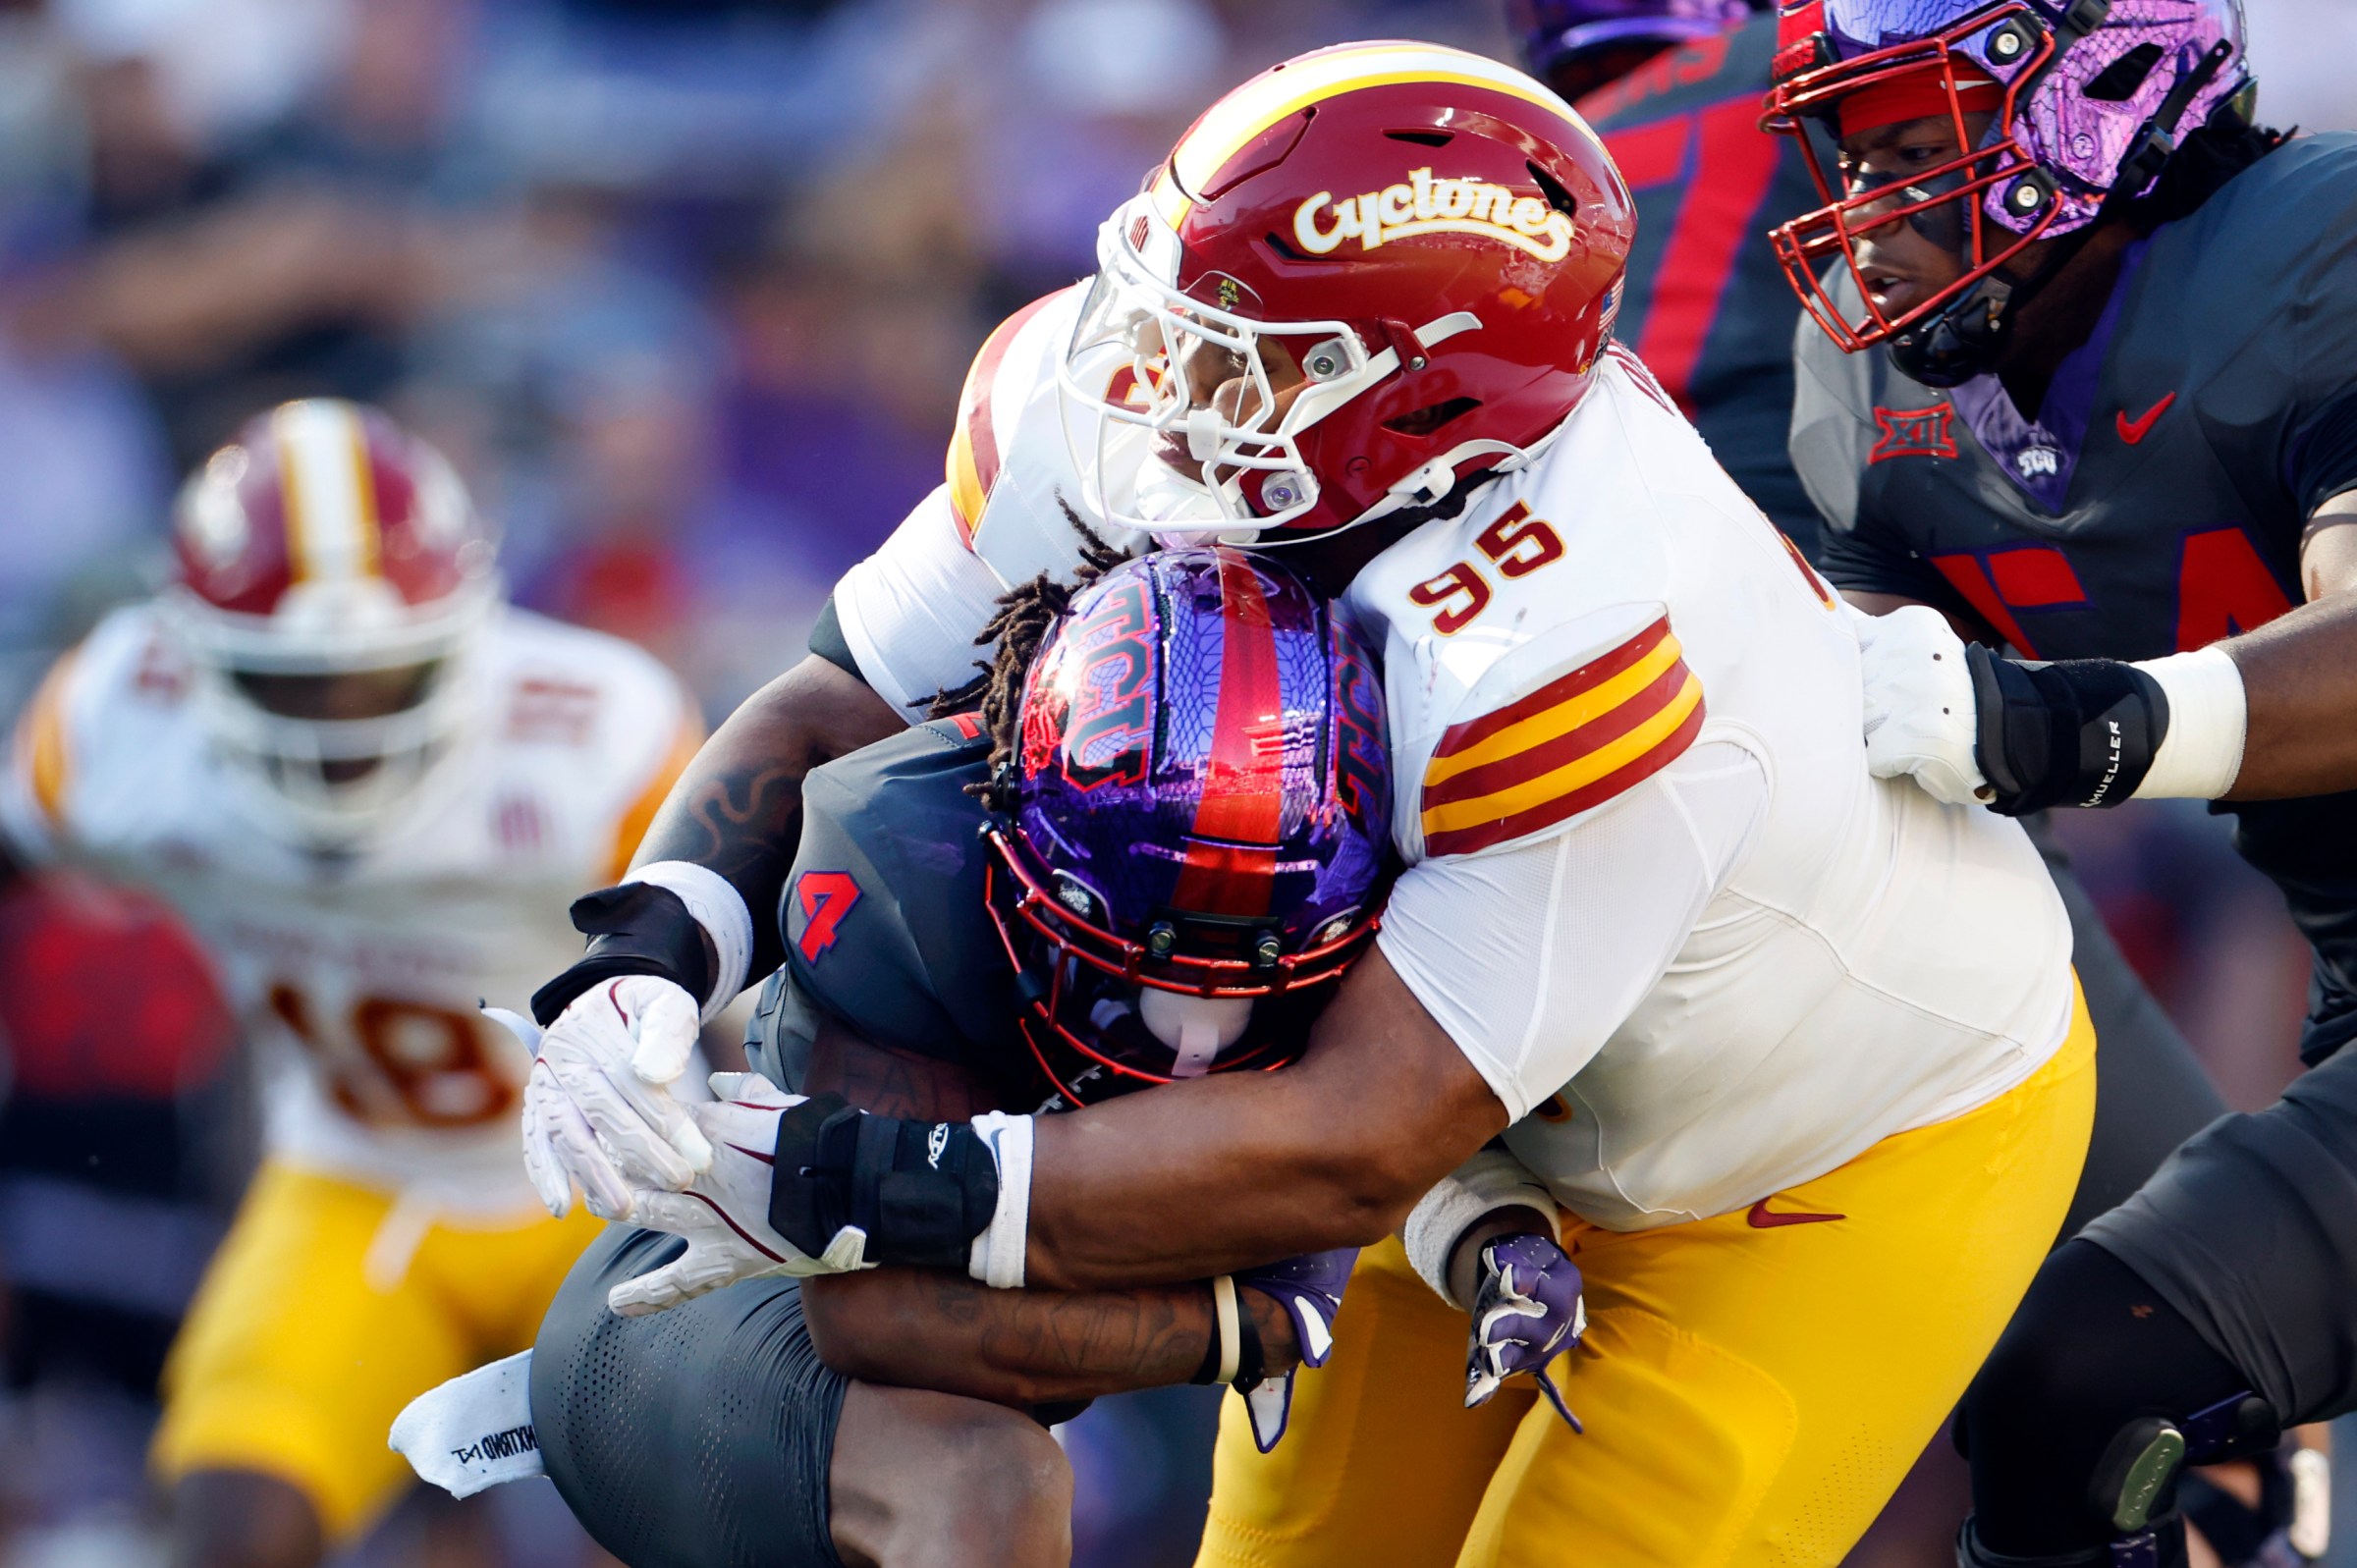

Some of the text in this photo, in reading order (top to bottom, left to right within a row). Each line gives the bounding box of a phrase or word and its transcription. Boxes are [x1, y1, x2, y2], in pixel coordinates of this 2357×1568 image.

[1293, 166, 1575, 262] Cyclones
[1872, 405, 1954, 459] XII
[1406, 498, 1568, 638] 95
[1059, 581, 1153, 793] TCU
[2079, 721, 2121, 807] MUELLER
[796, 870, 863, 967] 4
